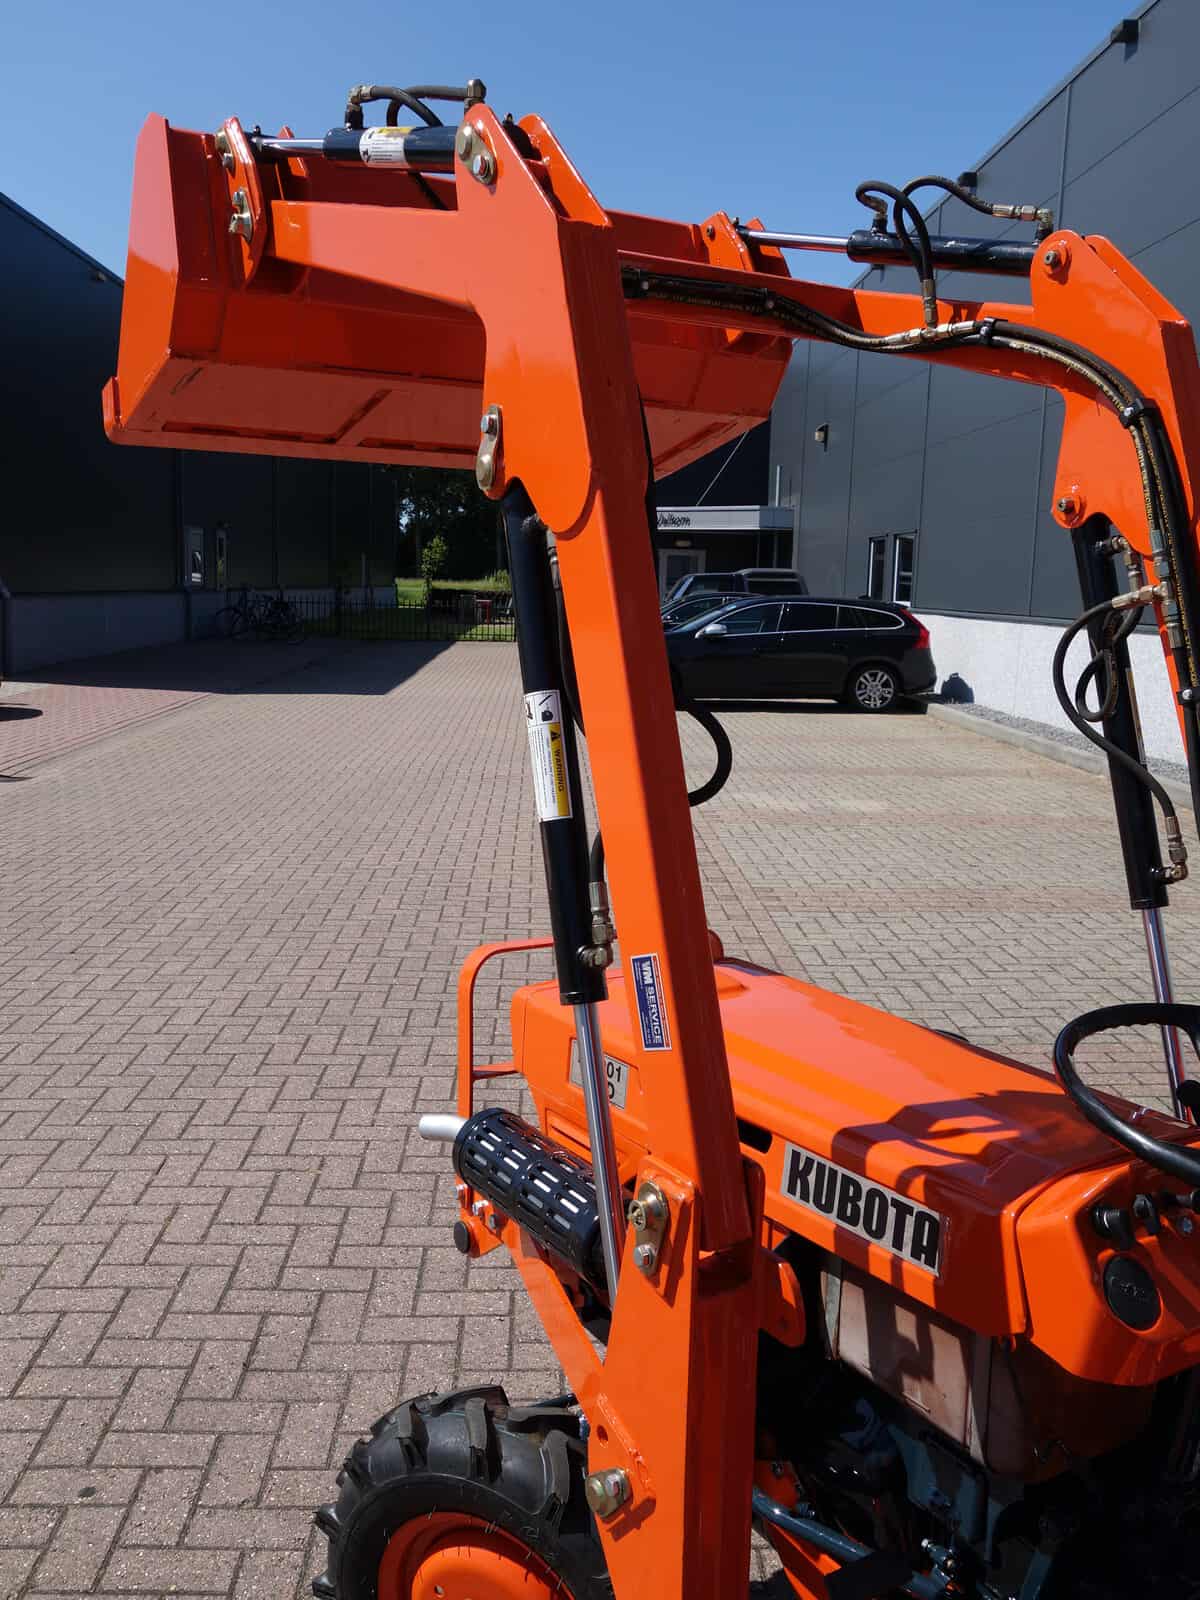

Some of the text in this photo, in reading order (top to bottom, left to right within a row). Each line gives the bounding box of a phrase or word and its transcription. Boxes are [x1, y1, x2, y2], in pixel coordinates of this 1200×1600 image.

[554, 748, 565, 793] WARNING
[648, 986, 663, 1044] SERVICE
[787, 1149, 940, 1269] KUBOTA
